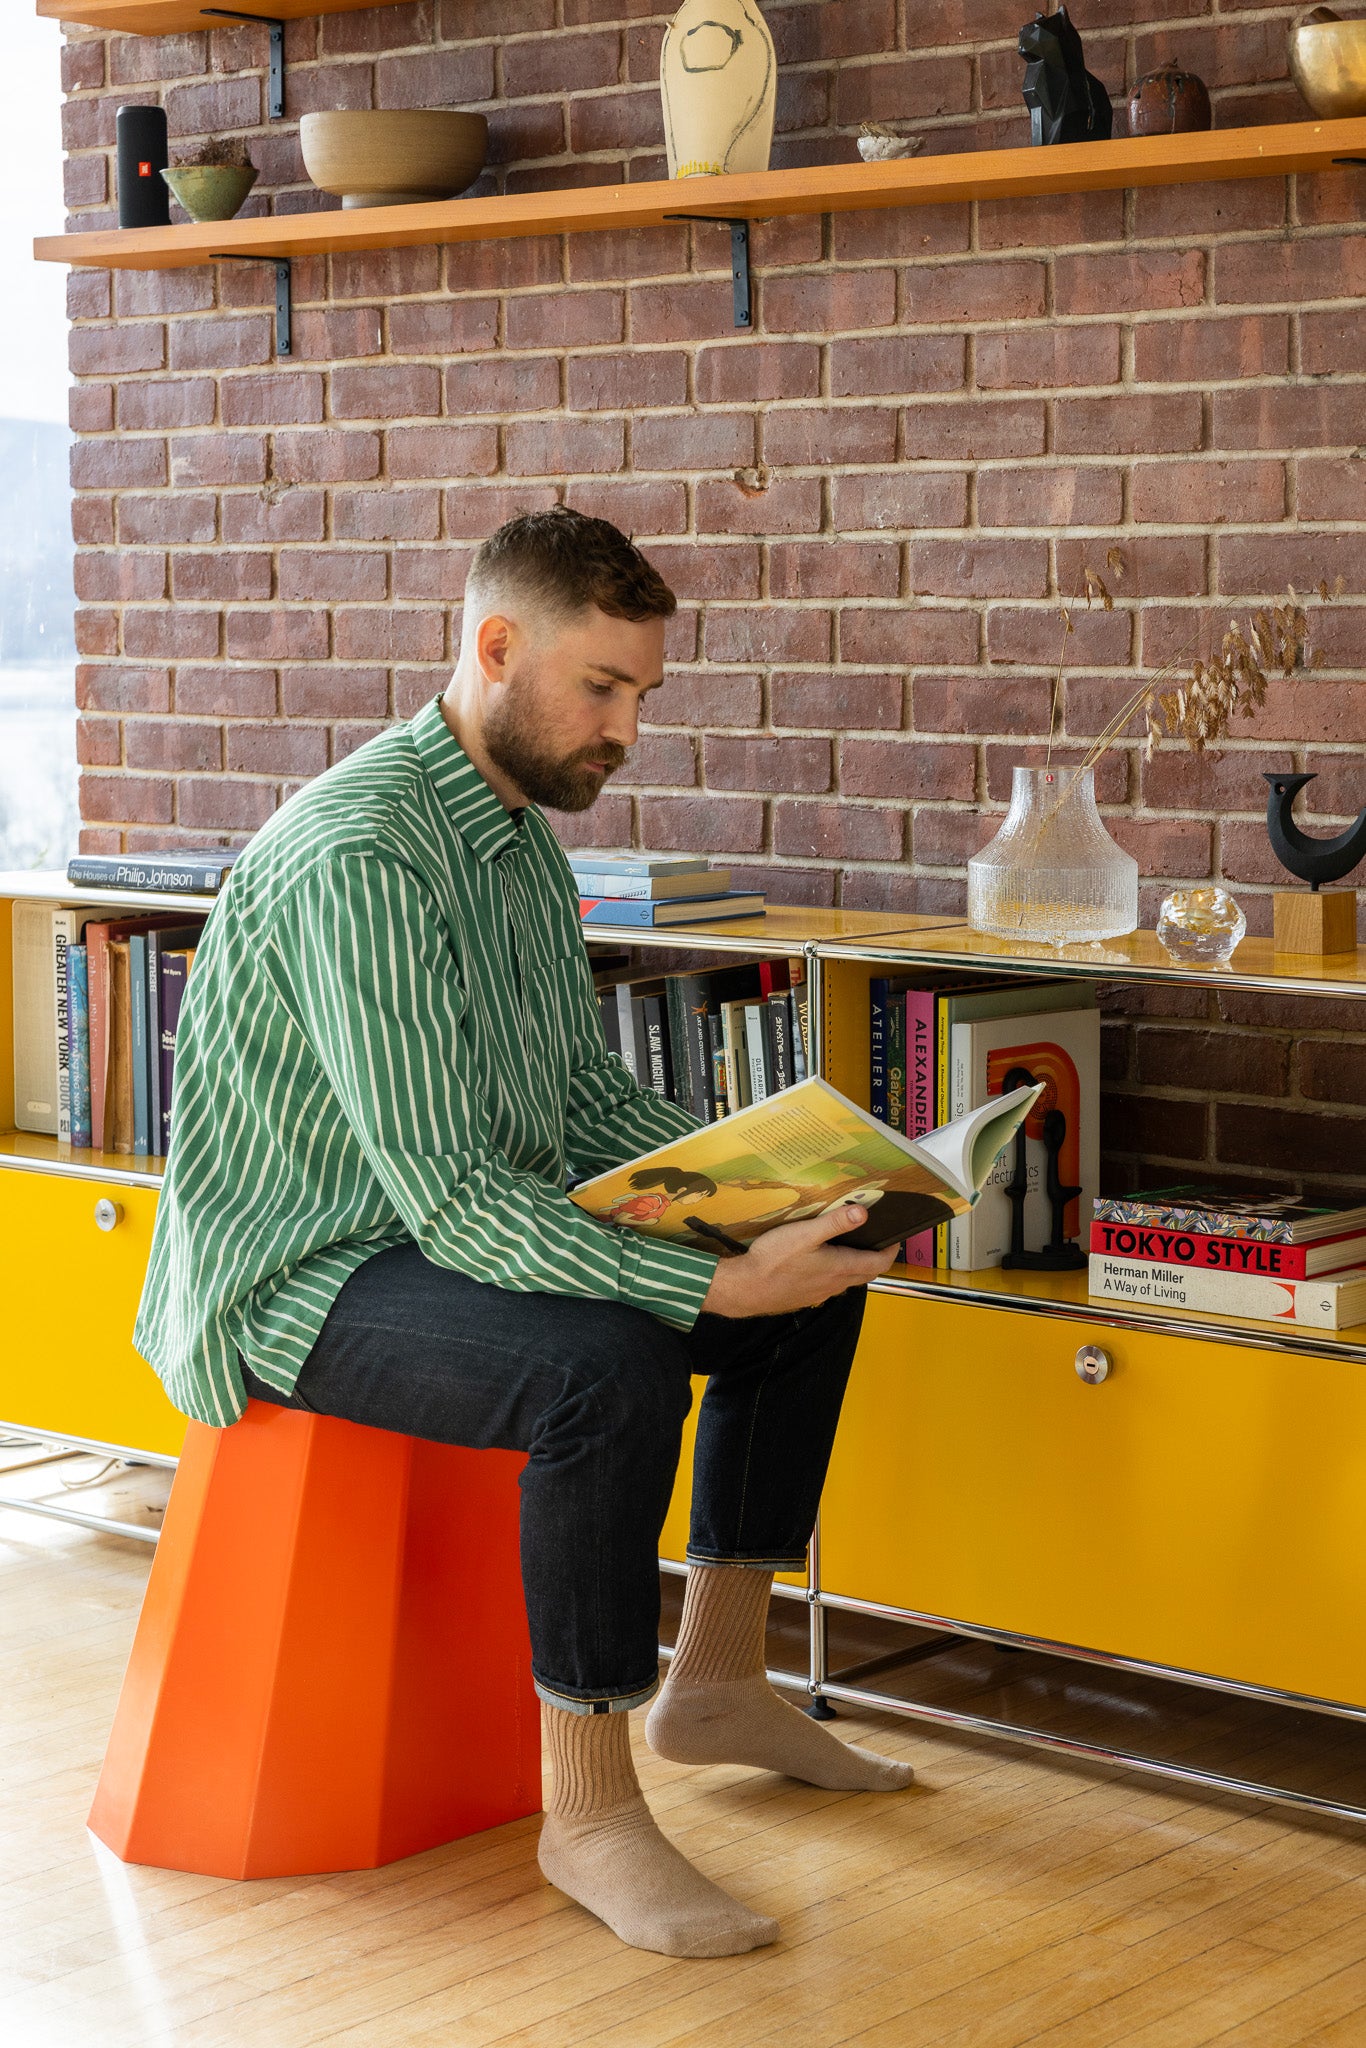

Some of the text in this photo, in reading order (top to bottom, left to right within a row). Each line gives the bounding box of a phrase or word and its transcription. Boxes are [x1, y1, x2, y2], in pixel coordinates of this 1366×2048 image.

[70, 867, 193, 887] The Houses of Philip Johnson
[149, 950, 157, 992] BERLIN
[57, 998, 68, 1030] NEW
[71, 985, 80, 1040] LANDSCAPE
[58, 1036, 70, 1070] YORK
[72, 1042, 80, 1088] PAINTING
[648, 1025, 665, 1094] SLAVA MOGUTIN
[872, 1004, 882, 1086] ATELIER
[60, 1075, 70, 1111] BOOK
[891, 1067, 901, 1126] Garden
[915, 1018, 927, 1136] ALEXANDER
[1102, 1228, 1281, 1273] TOKYO STYLE
[1104, 1263, 1184, 1284] Herman Miller
[1104, 1279, 1186, 1302] A Way of Living
